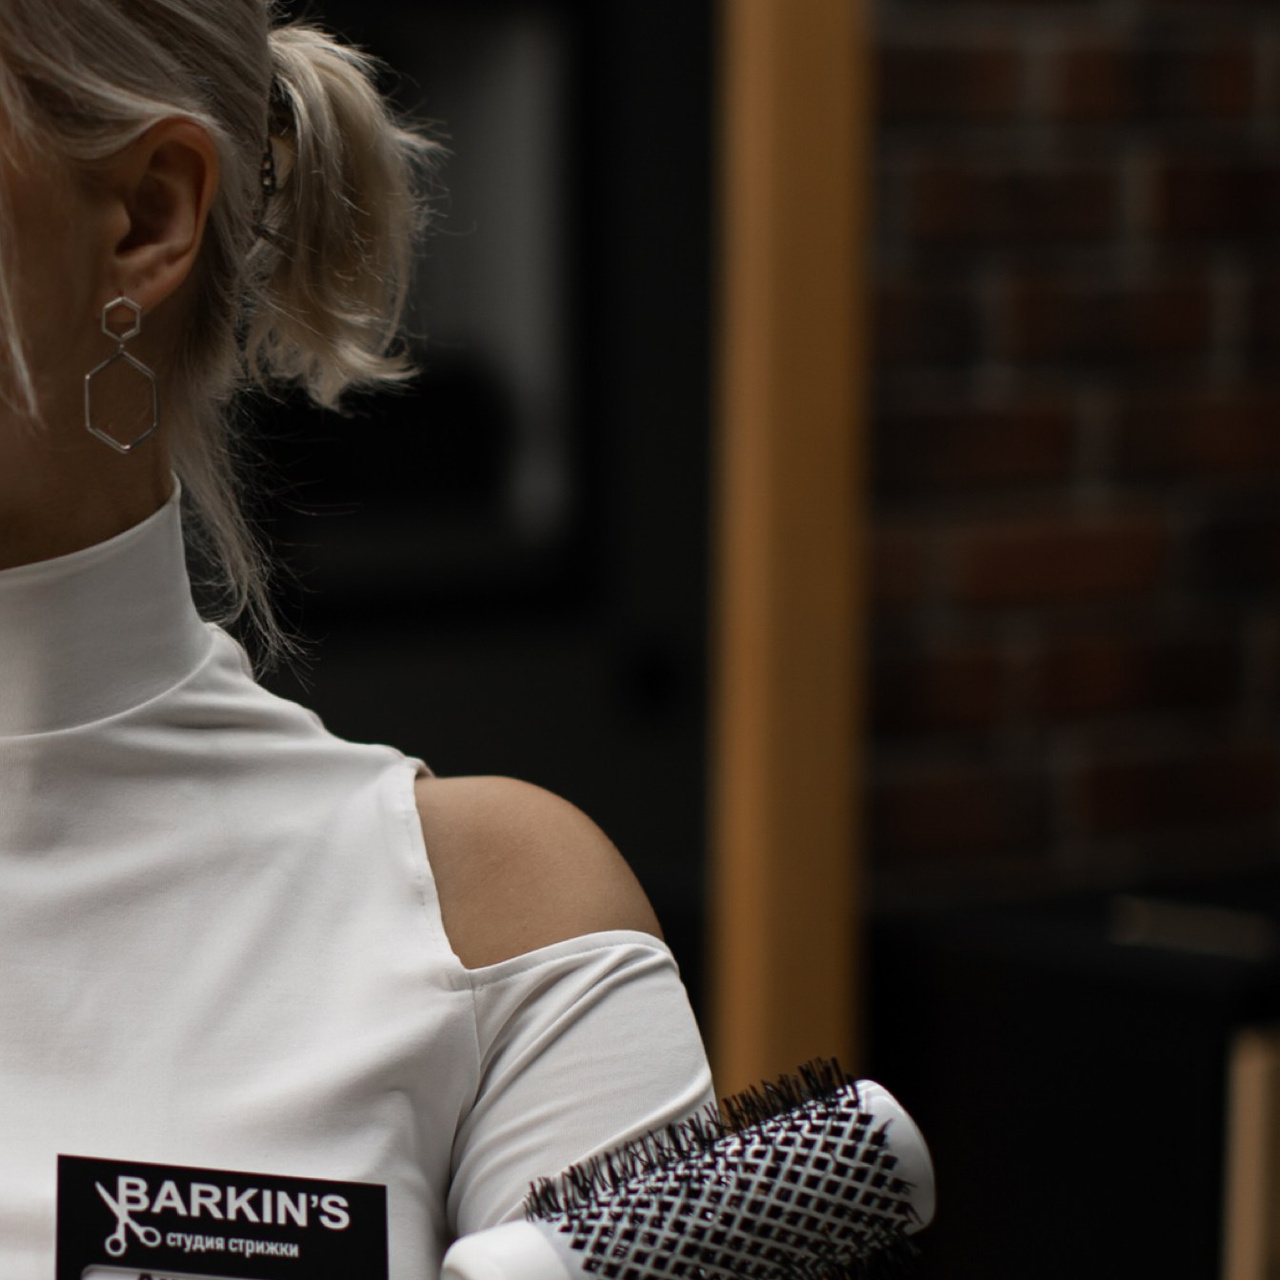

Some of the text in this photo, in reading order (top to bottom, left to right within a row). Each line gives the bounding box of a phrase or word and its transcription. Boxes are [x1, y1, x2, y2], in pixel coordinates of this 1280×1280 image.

[117, 1175, 351, 1230] BARKIN'S
[166, 1232, 299, 1258] студия стрижки
